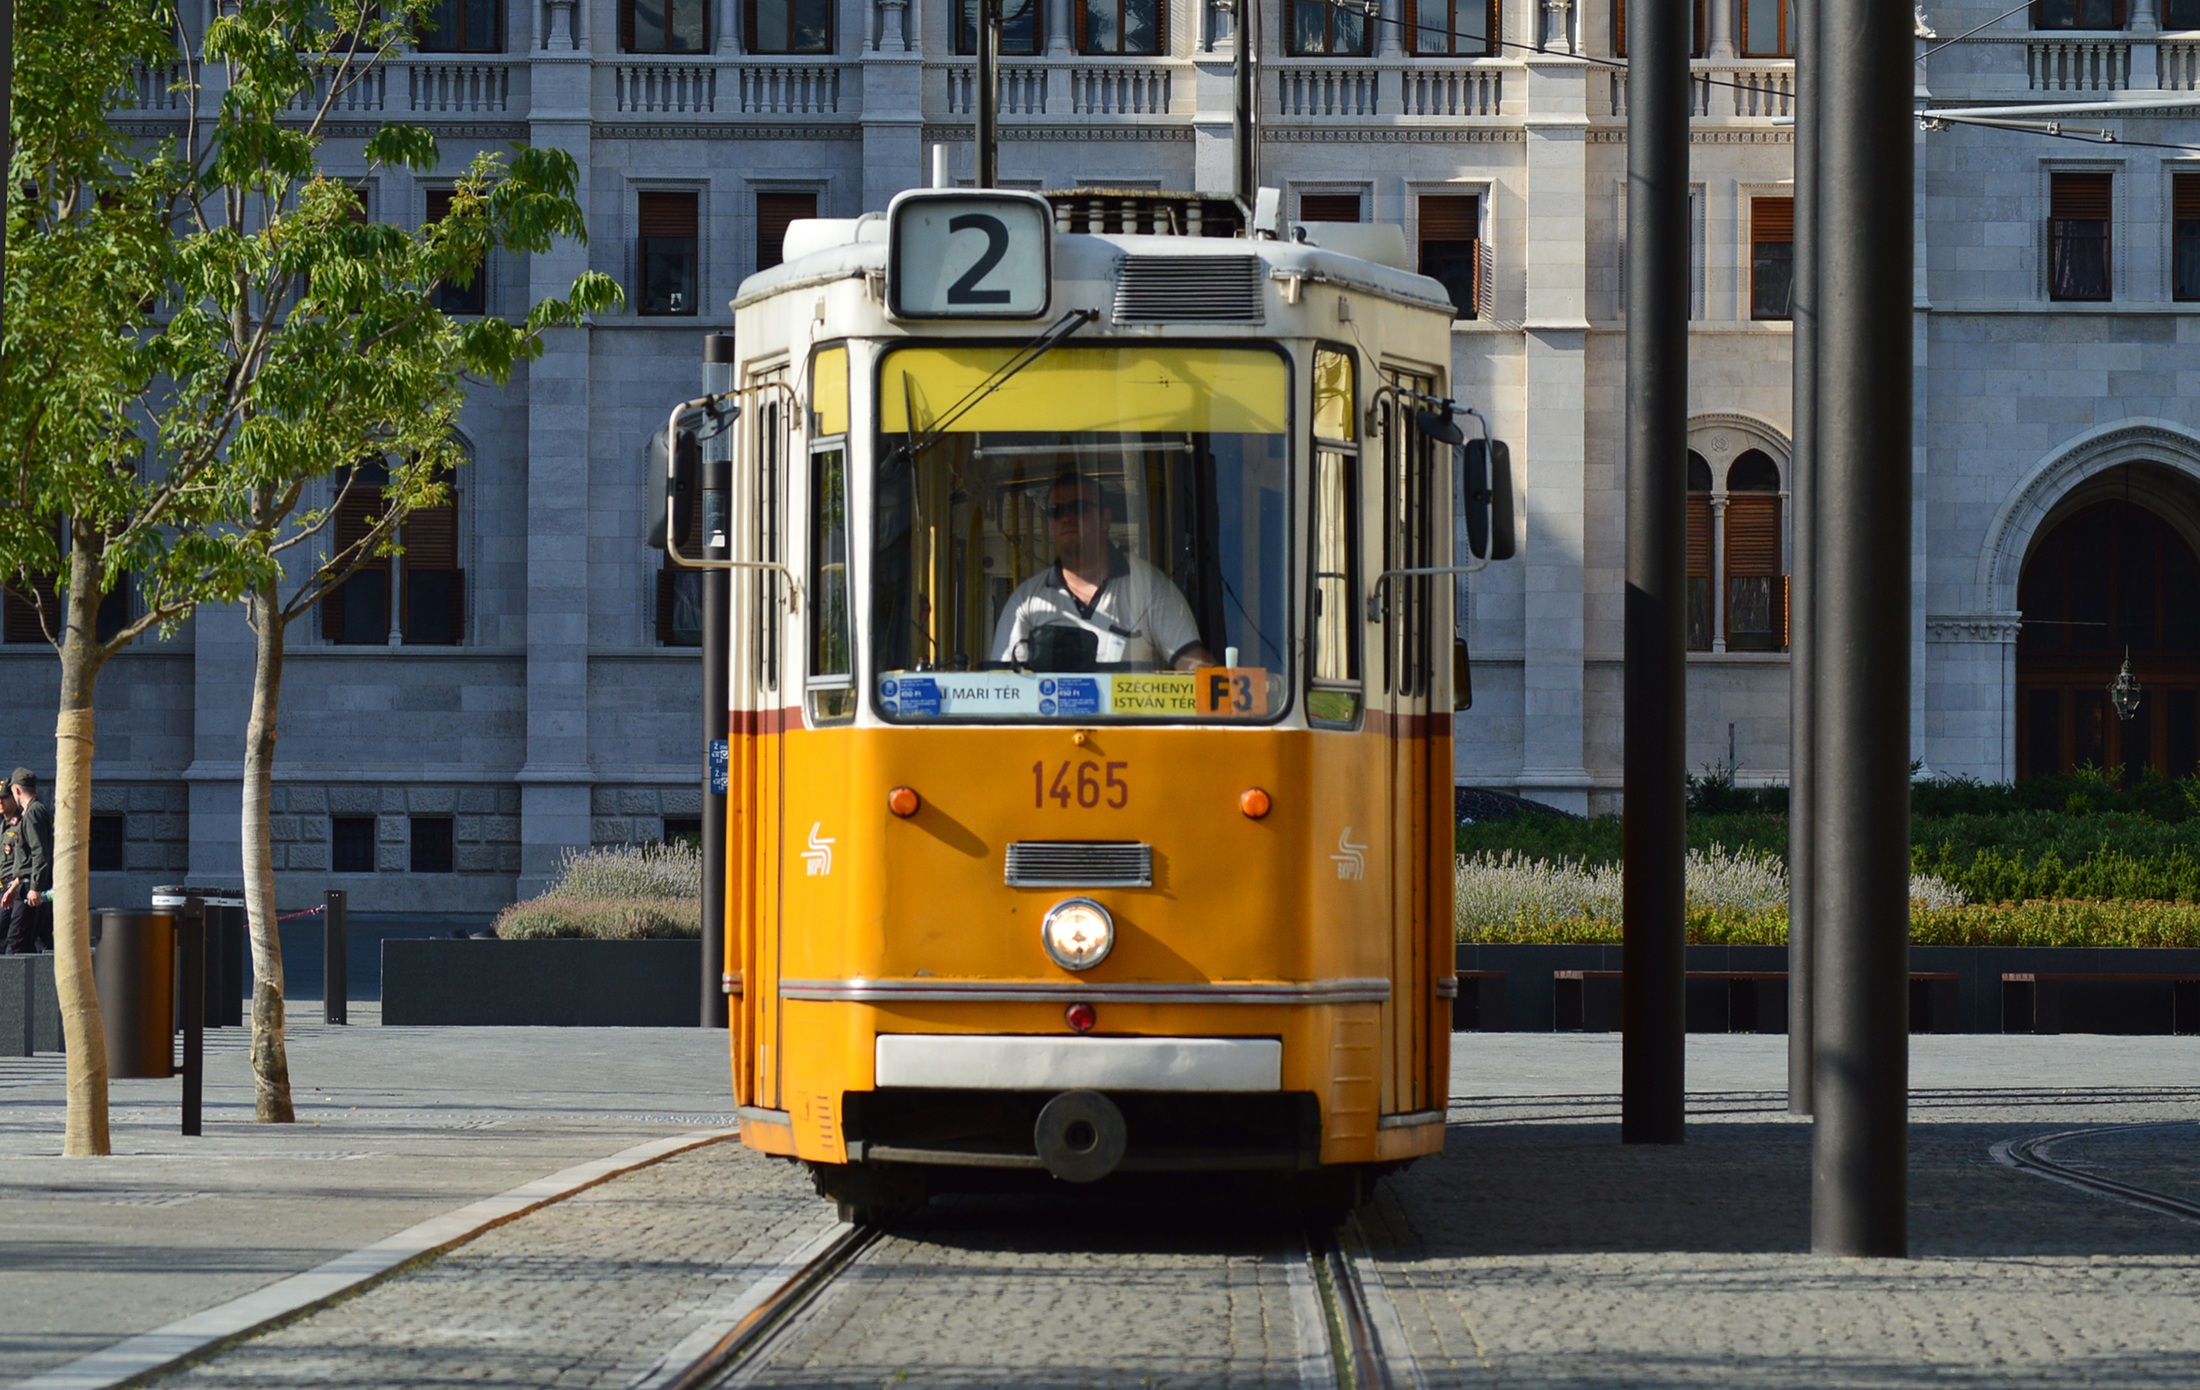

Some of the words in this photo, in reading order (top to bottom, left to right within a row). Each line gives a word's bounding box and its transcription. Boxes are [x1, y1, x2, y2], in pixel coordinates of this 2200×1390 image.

[947, 213, 1011, 305] 2
[952, 688, 989, 700] MARI
[994, 684, 1020, 700] TÉR
[1117, 679, 1194, 694] SZÉCHENYI
[1210, 675, 1253, 712] F3
[1114, 694, 1165, 708] ISTVÁN
[1170, 695, 1196, 709] TÉR
[1032, 760, 1128, 809] 1465
